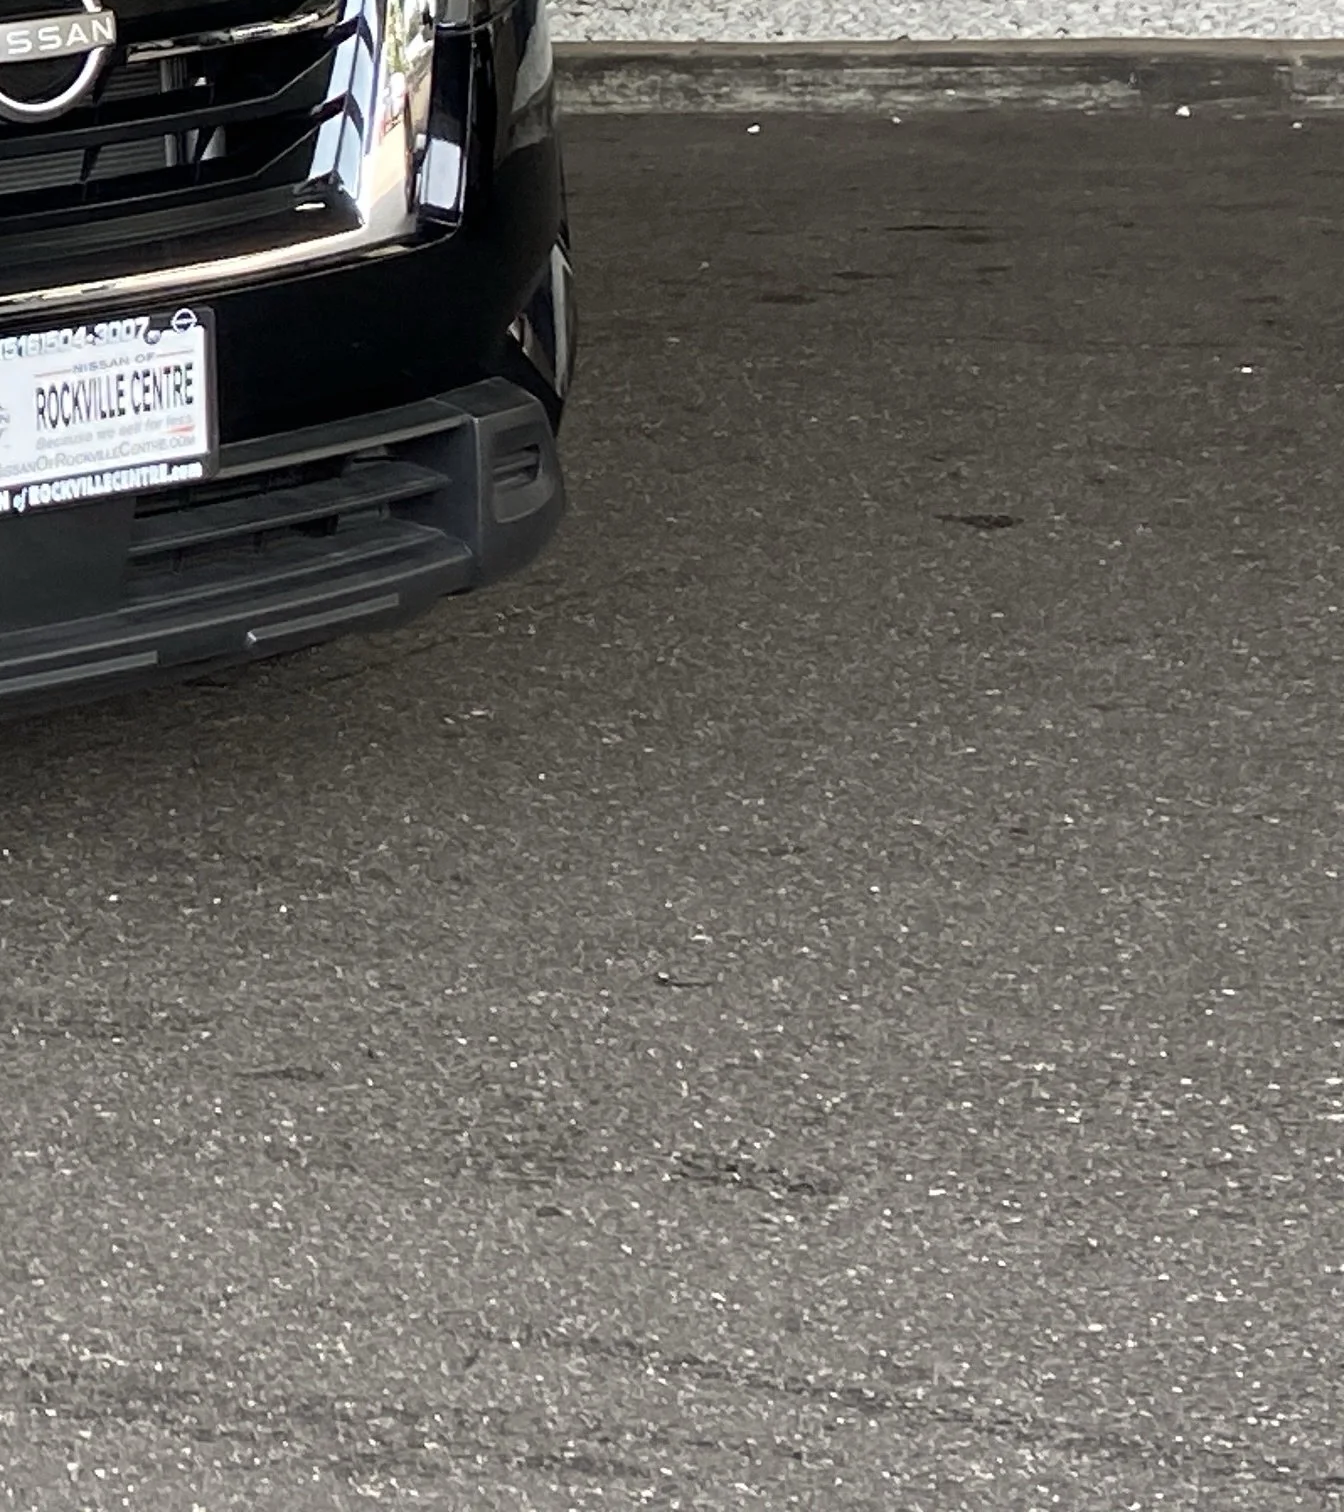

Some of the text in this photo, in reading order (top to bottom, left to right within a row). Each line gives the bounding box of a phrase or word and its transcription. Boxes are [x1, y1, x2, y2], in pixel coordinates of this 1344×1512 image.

[72, 352, 156, 374] NISSAN OF
[36, 362, 194, 431] ROCKVILLE CENTRE
[12, 487, 28, 513] of
